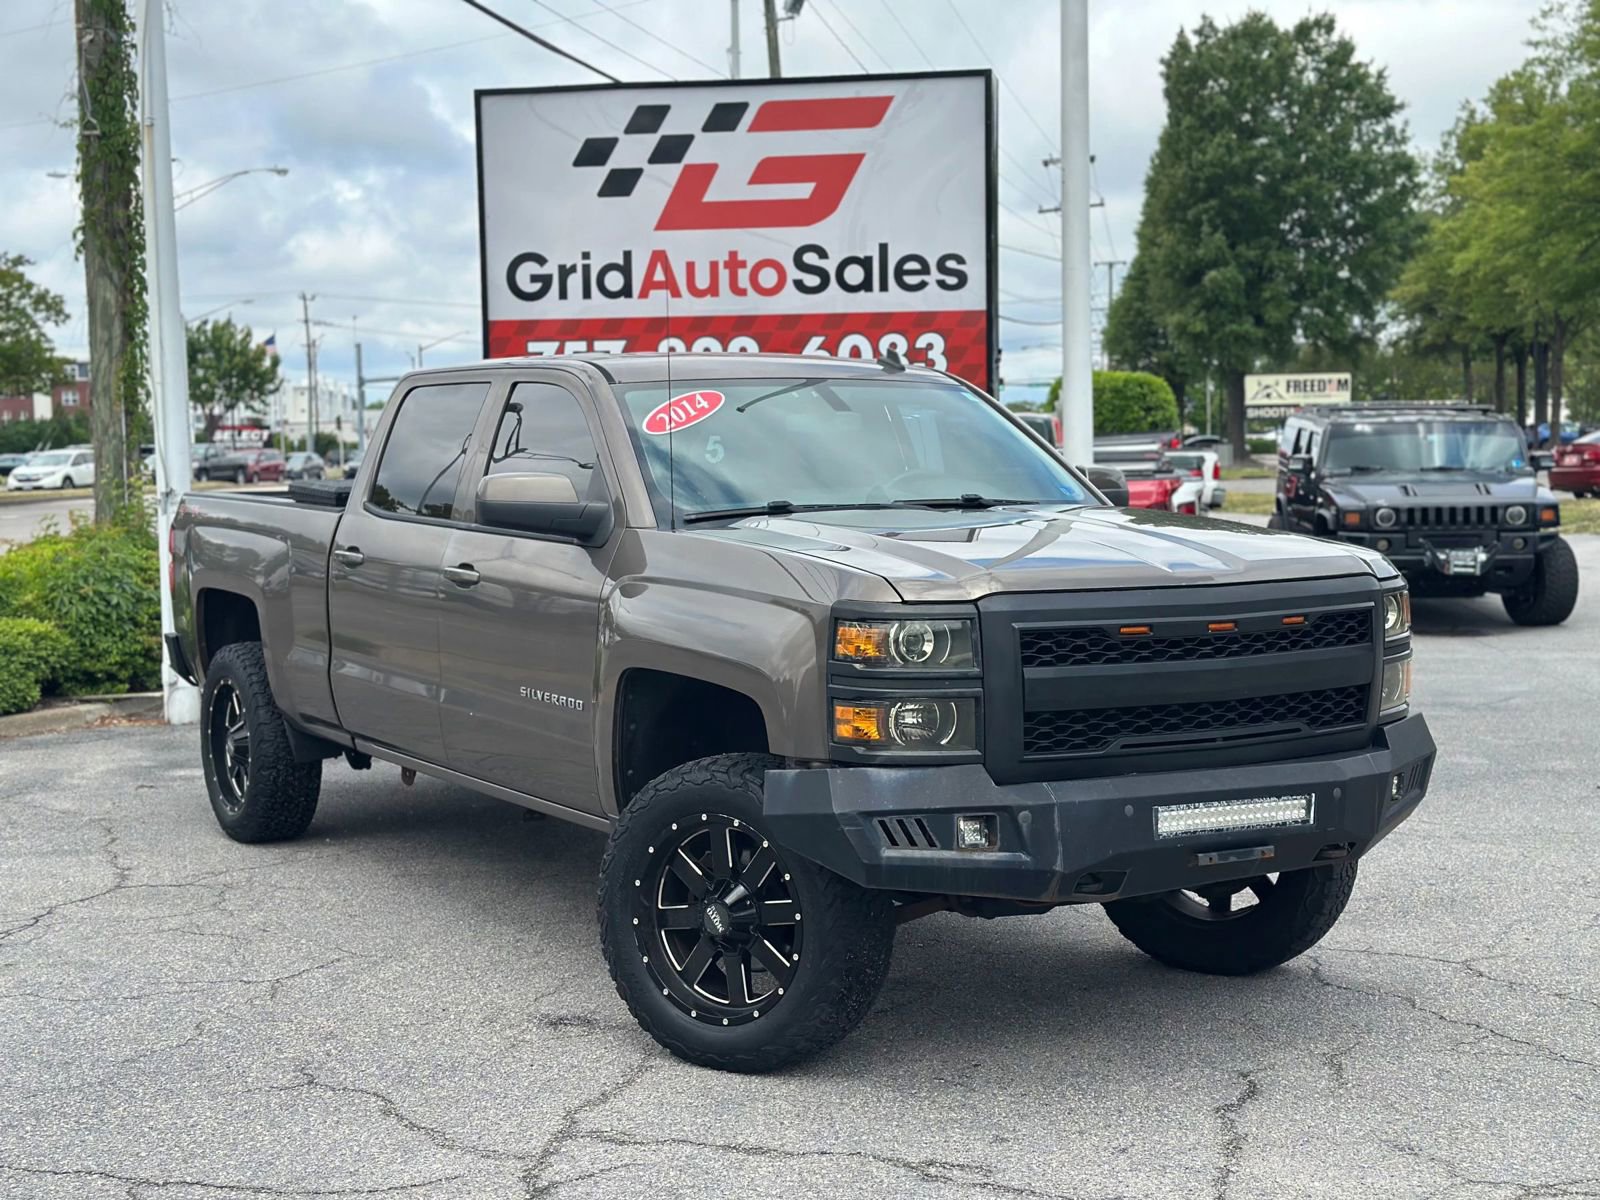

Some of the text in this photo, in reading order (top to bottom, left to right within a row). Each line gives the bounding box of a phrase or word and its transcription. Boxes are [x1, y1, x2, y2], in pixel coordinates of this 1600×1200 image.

[656, 393, 710, 431] 2014
[704, 435, 725, 464] 5
[520, 686, 583, 711] SILVERADO
